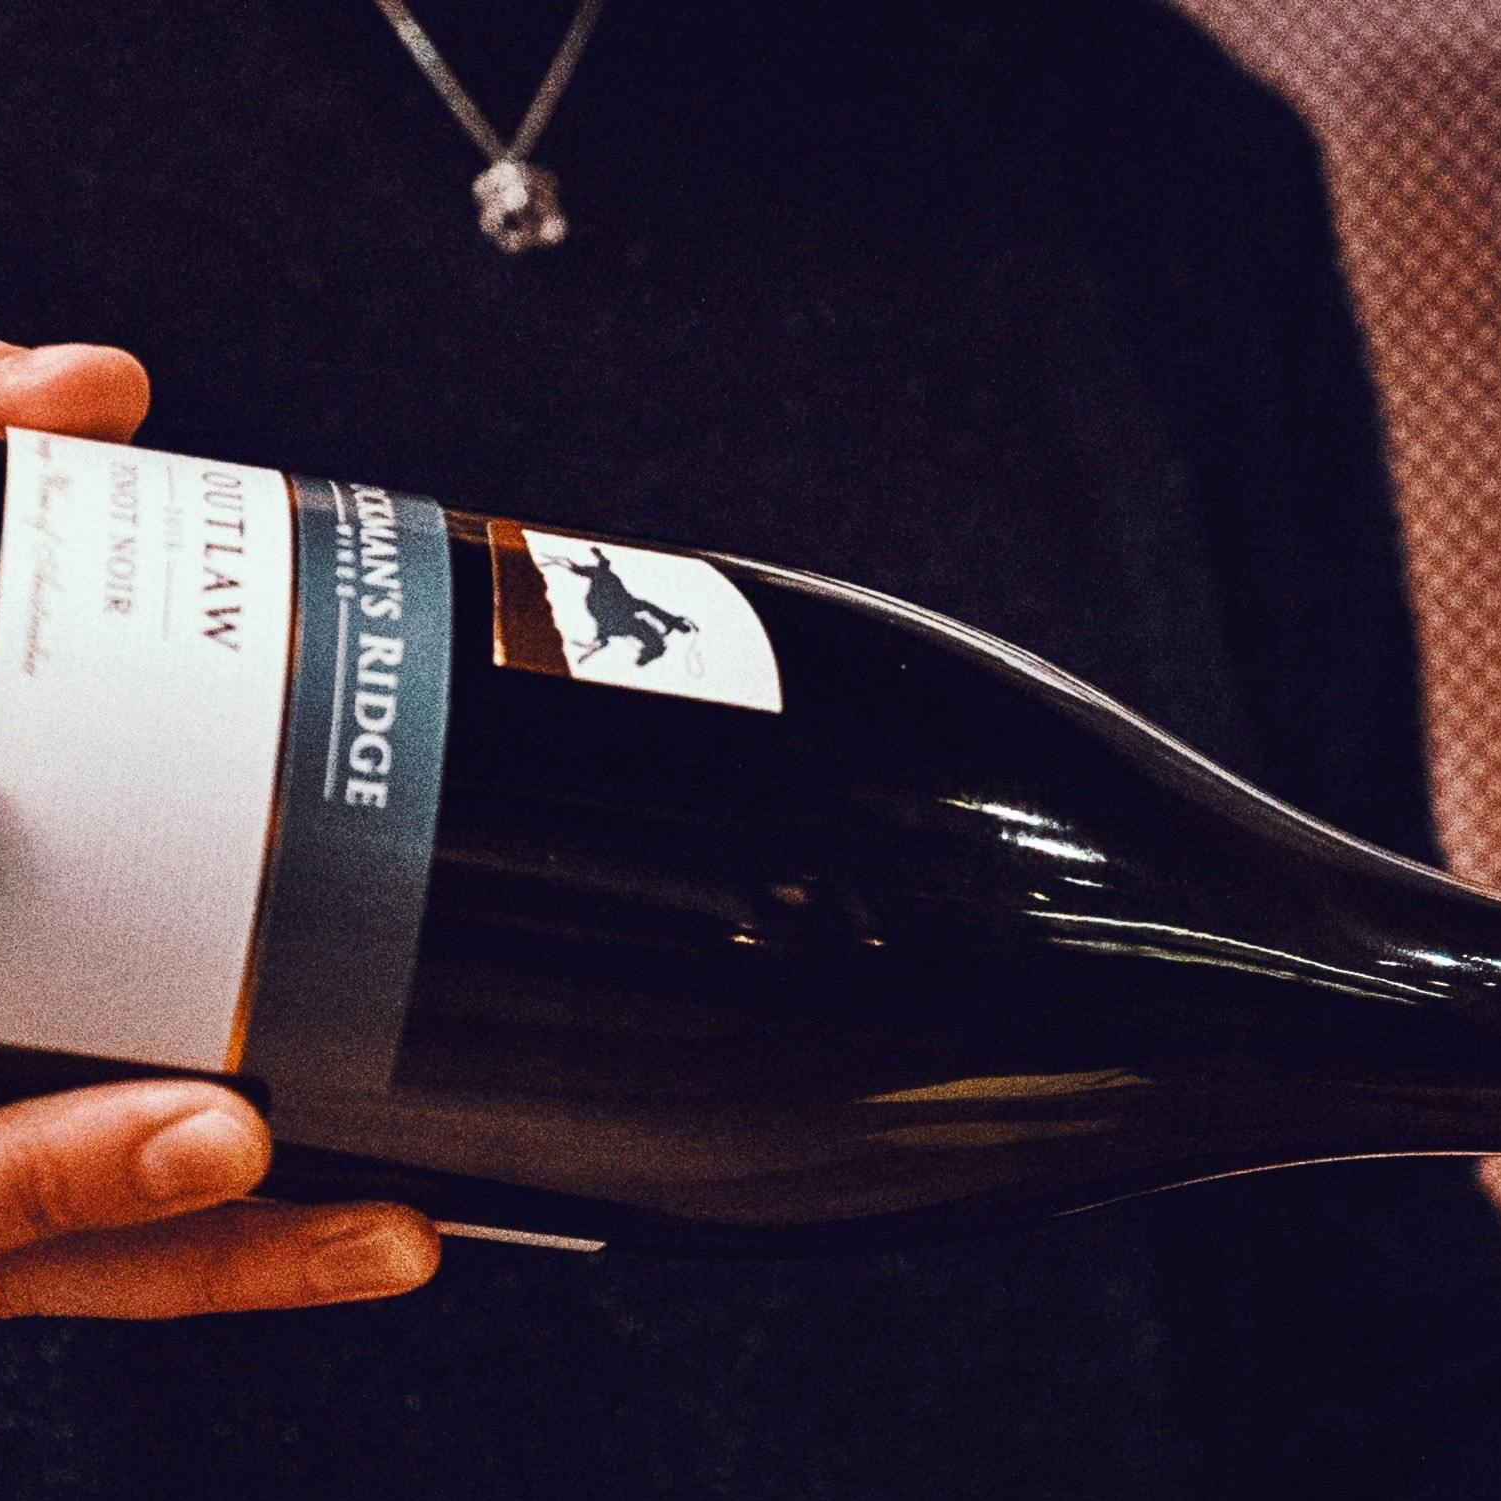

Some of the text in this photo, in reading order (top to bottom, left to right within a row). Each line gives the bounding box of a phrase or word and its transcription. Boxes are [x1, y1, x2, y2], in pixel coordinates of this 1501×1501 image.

[102, 459, 141, 616] PINOT NOIR
[202, 470, 245, 653] OUTLAW
[344, 632, 405, 809] RIDGE
